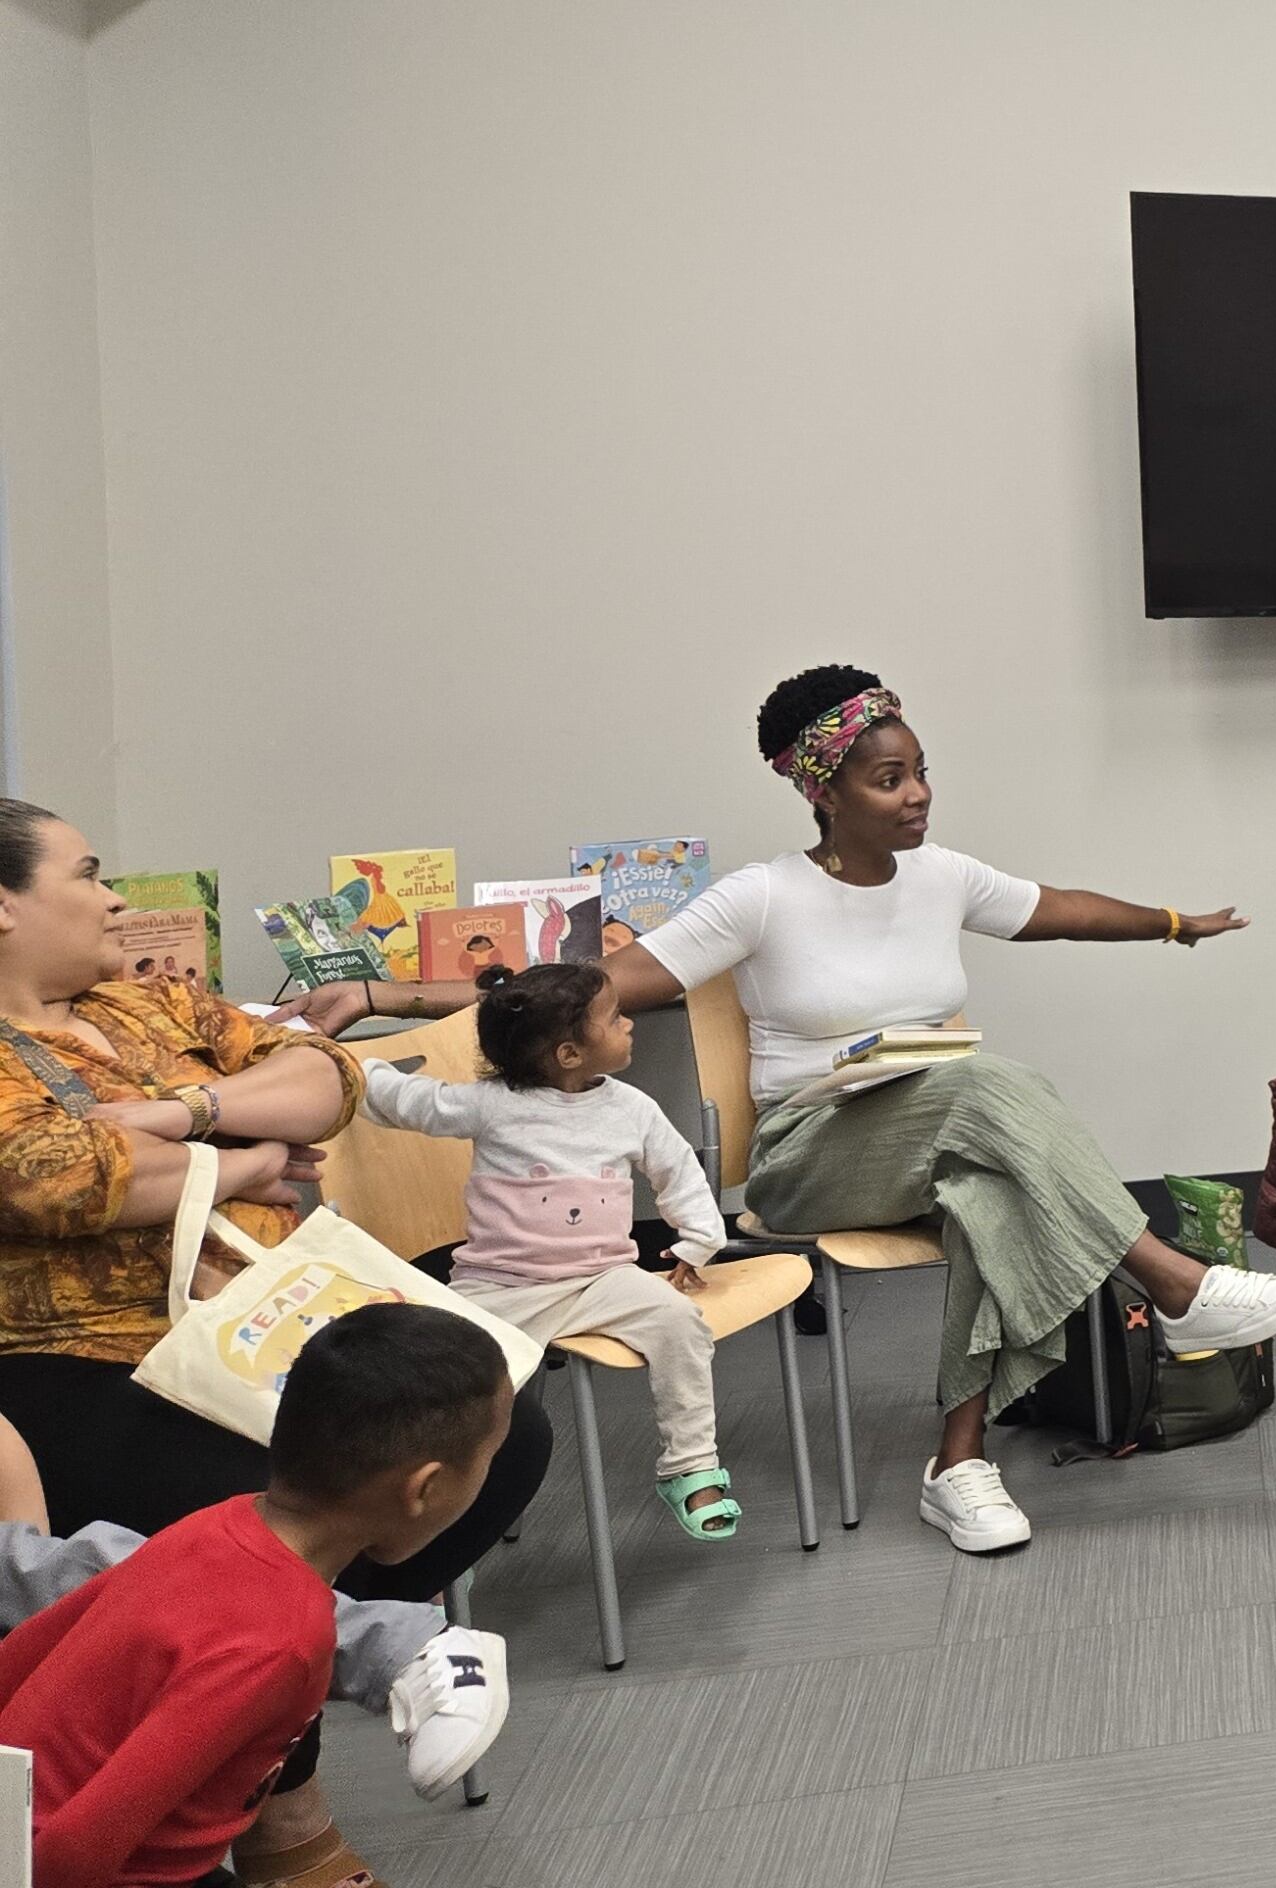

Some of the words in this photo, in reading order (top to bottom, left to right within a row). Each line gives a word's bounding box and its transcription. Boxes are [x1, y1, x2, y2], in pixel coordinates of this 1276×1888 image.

[396, 880, 455, 898] callaba!
[519, 888, 530, 897] el
[532, 882, 591, 896] armadillo
[455, 919, 503, 935] Dolores
[238, 1276, 321, 1346] READ!
